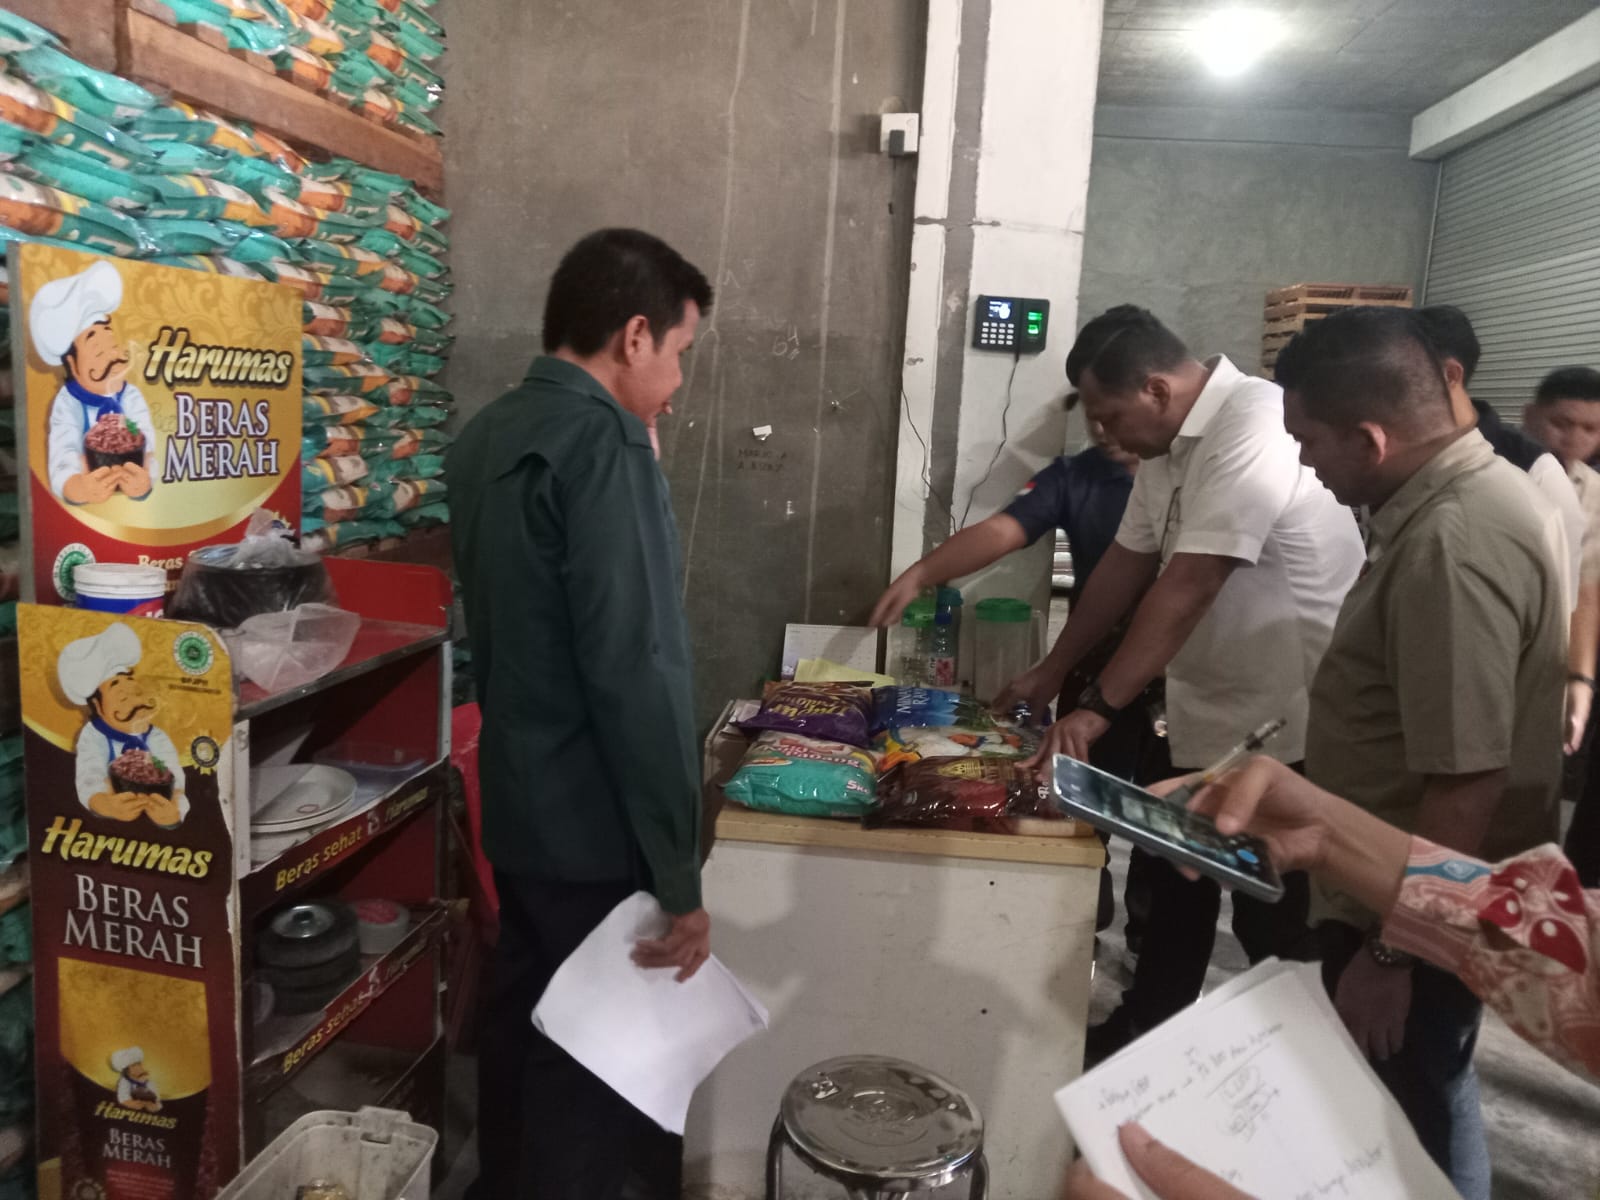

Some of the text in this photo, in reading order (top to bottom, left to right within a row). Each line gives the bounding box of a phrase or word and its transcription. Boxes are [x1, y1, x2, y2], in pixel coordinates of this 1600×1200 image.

[145, 326, 293, 388] Harumas
[175, 392, 270, 440] BERAS
[163, 437, 280, 483] MERAH
[41, 816, 213, 878] Harumas
[275, 854, 320, 892] Beras
[322, 825, 363, 864] sehat
[75, 874, 190, 928] BERAS
[63, 910, 204, 968] MERAH
[95, 1101, 178, 1129] Harumas
[109, 1128, 165, 1152] BERAS
[102, 1143, 172, 1169] MERAH
